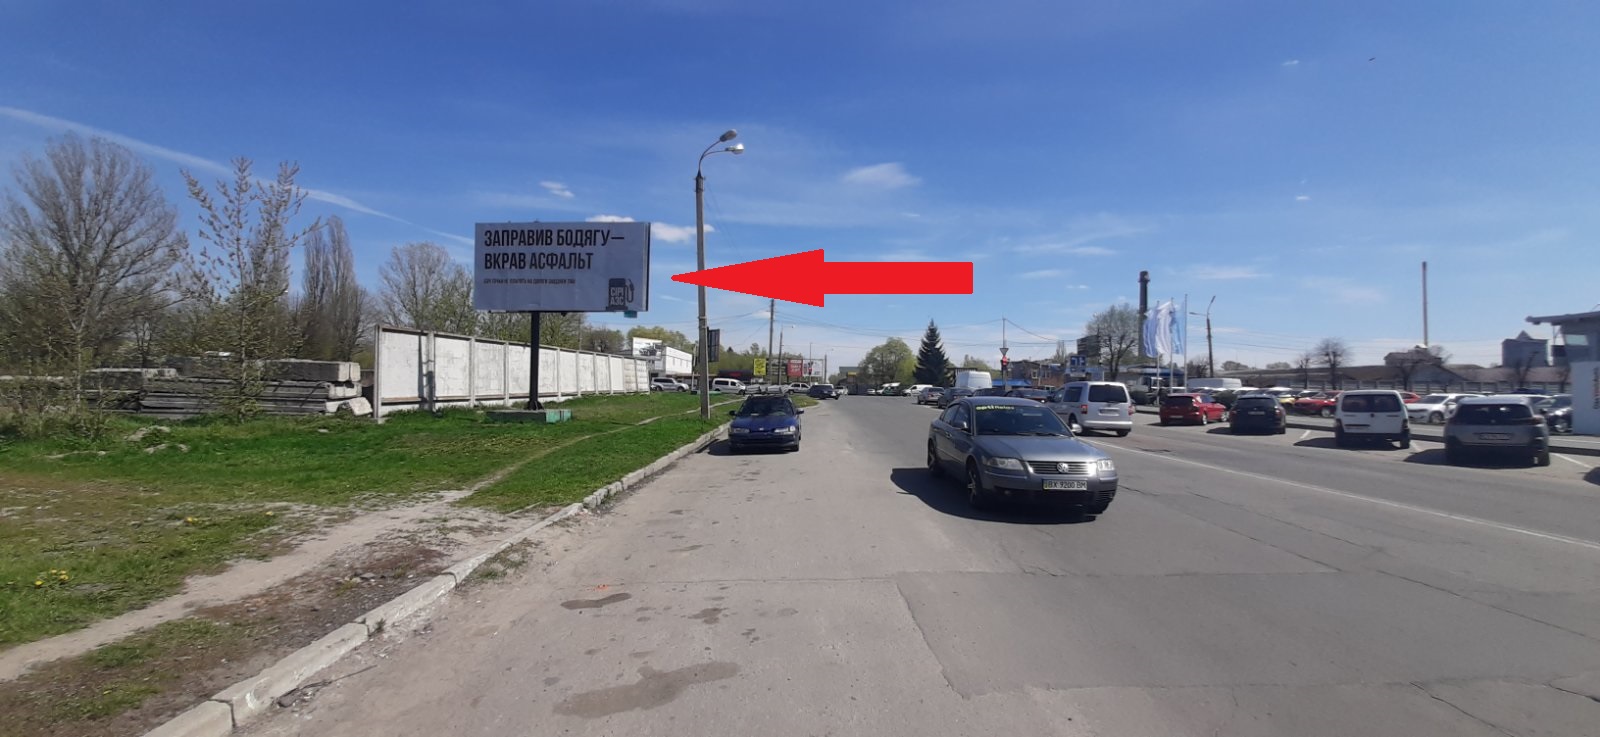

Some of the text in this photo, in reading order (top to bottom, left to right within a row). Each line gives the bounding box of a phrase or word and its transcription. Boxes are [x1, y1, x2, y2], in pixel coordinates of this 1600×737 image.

[484, 229, 553, 247] ЗАПРАВИВ
[484, 252, 594, 270] ВКРАВ АСФАЛЬТ
